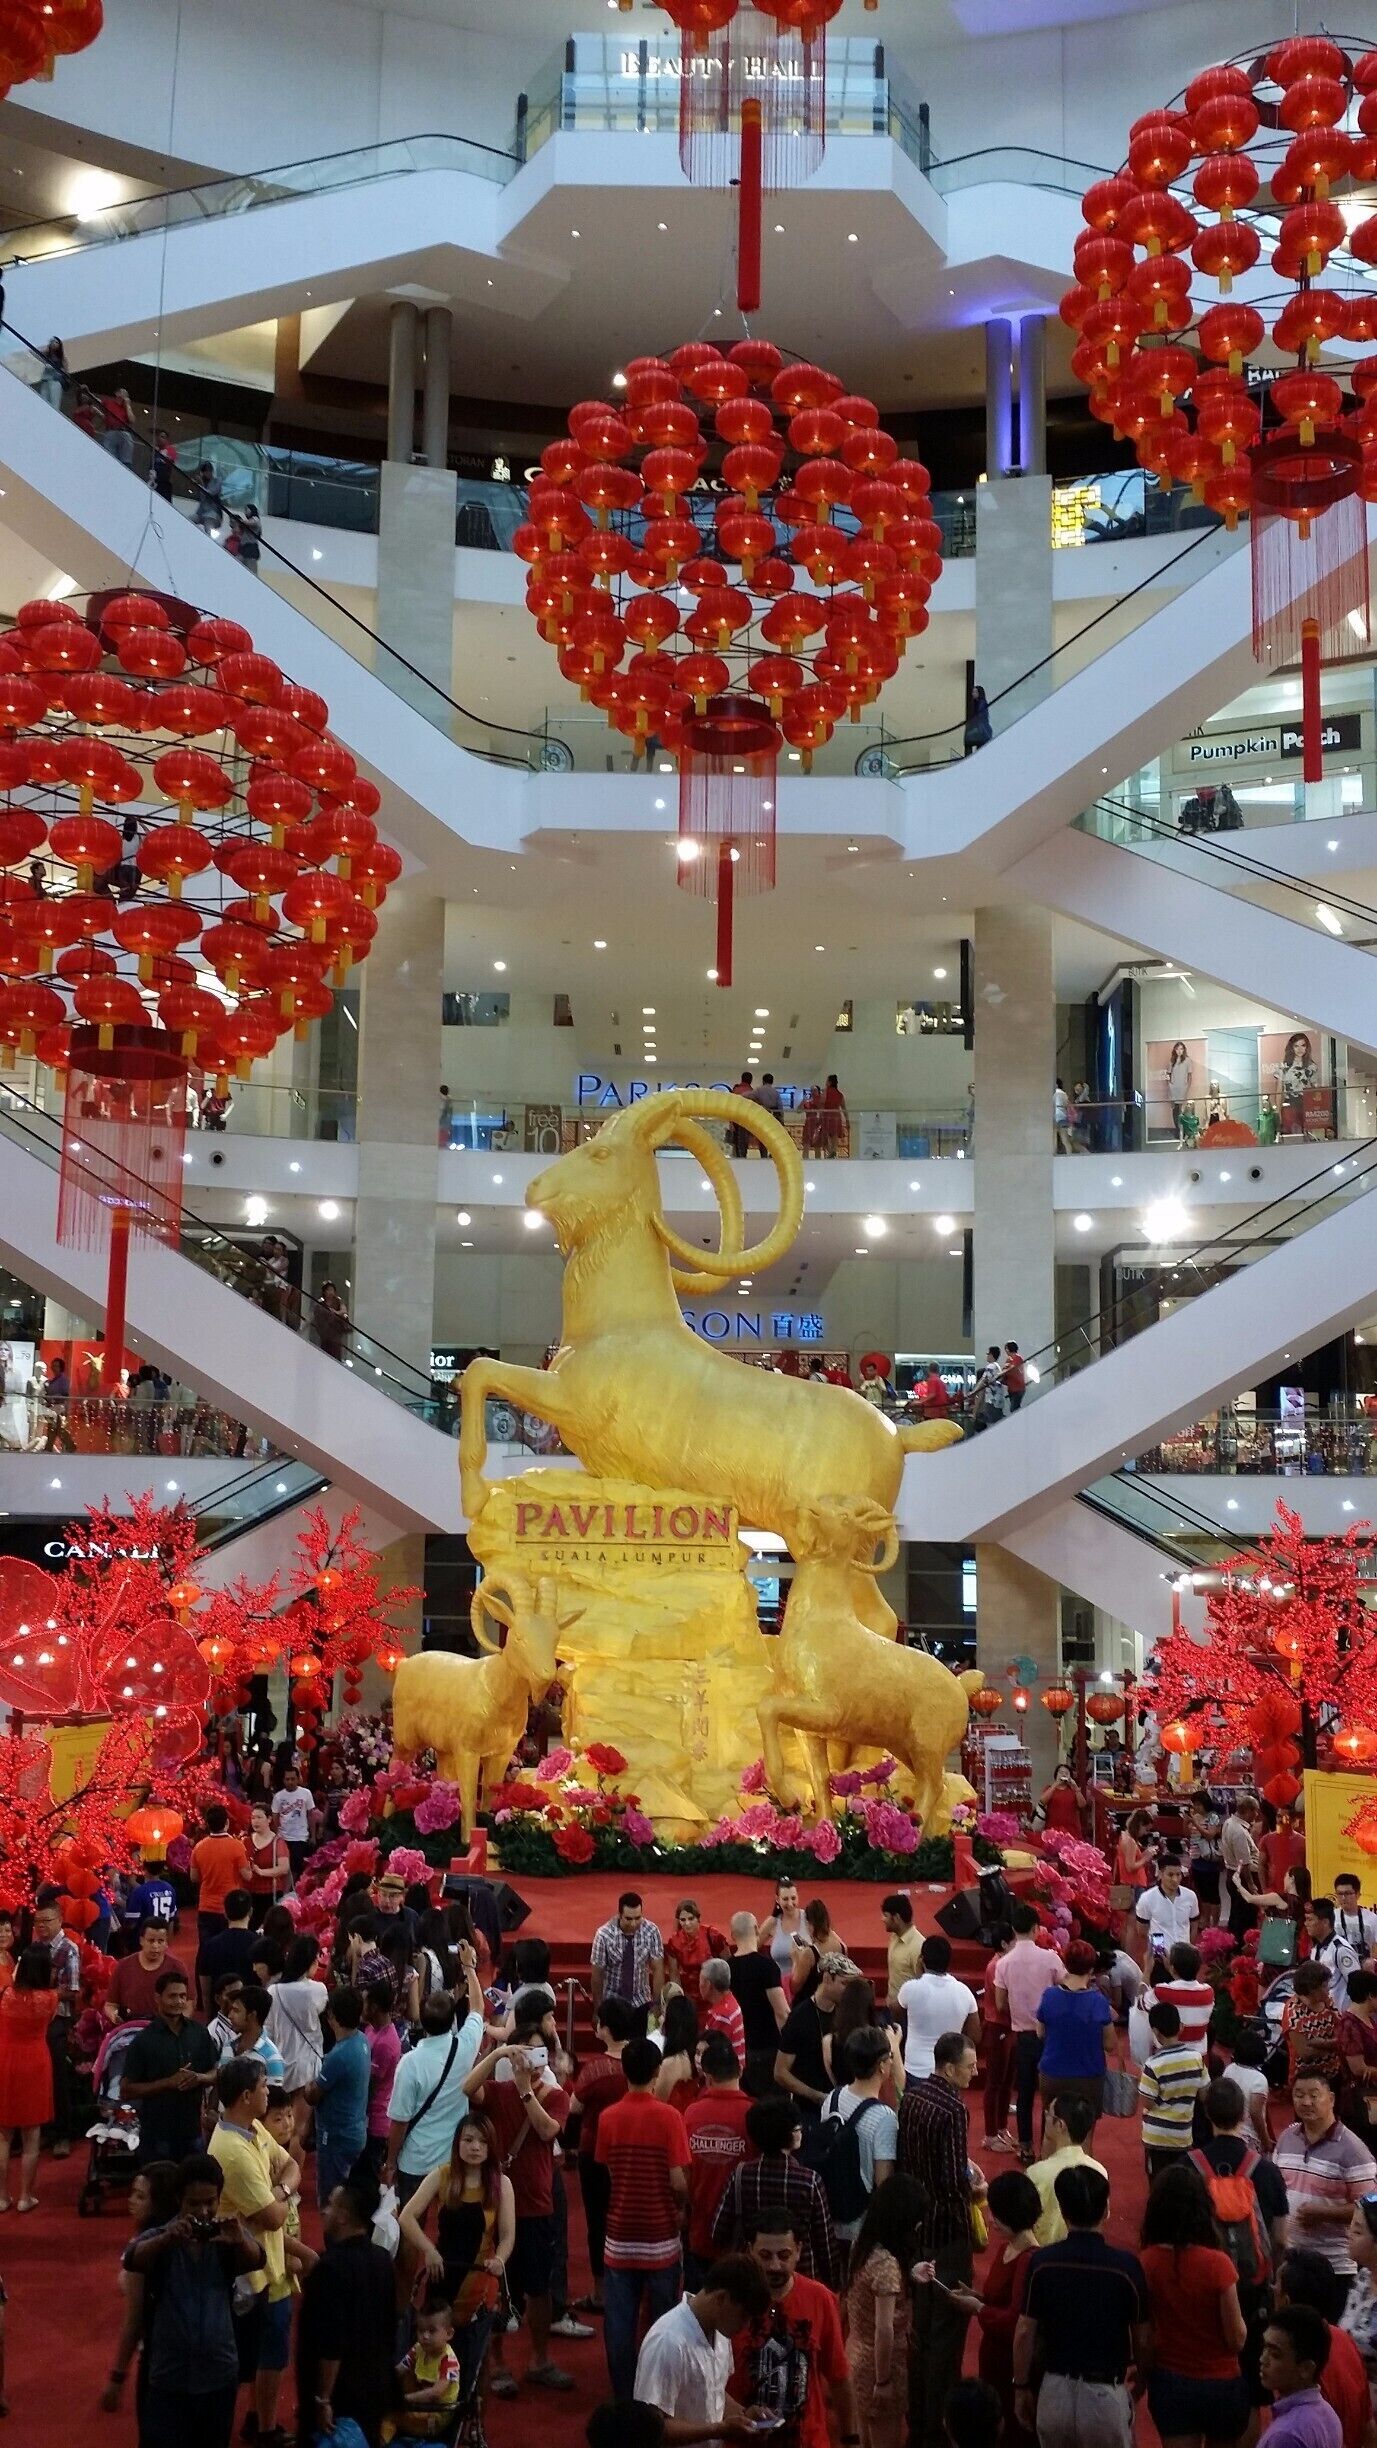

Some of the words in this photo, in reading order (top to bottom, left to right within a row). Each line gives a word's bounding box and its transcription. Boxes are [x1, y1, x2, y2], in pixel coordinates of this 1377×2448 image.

[620, 52, 734, 79] BEAUTY
[744, 55, 823, 80] HALL
[1190, 736, 1278, 761] Pumpkin
[682, 1311, 760, 1339] SON
[771, 1313, 824, 1339] 百盛
[430, 1351, 455, 1367] ior
[516, 1502, 733, 1540] PAVILION
[622, 1551, 707, 1564] LUMPUR
[152, 1896, 172, 1922] 15
[689, 2136, 746, 2153] CHALLENGER
